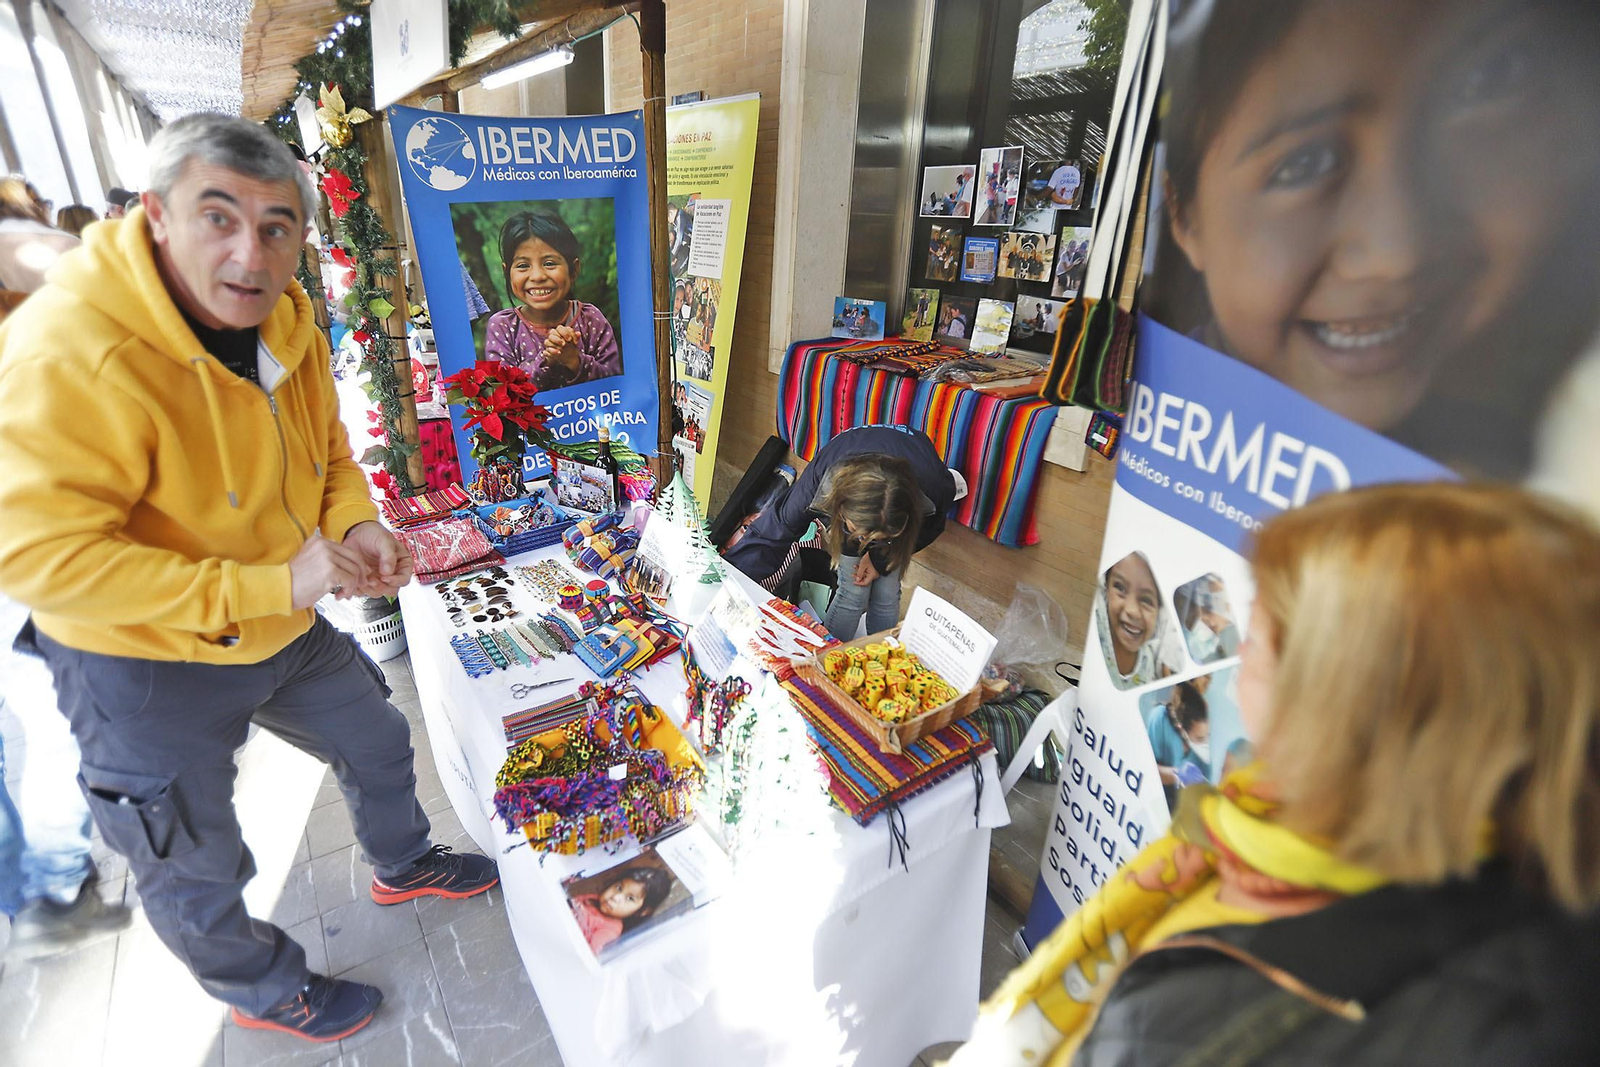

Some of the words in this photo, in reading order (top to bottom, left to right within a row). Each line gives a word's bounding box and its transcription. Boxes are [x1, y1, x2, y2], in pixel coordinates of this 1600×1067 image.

[477, 126, 637, 165] IBERMED
[483, 166, 535, 181] Médicos
[538, 170, 560, 180] con
[563, 166, 637, 180] Iberoamérica
[599, 389, 621, 408] DE
[603, 410, 648, 428] PARA
[1124, 380, 1351, 511] IBERMED
[1121, 447, 1171, 488] Médicos
[1173, 479, 1204, 503] con
[924, 607, 977, 653] QUITAPENAS
[937, 628, 966, 656] GUATEMALA
[1073, 706, 1144, 797] Salud
[1067, 743, 1149, 848] Iguald
[1048, 846, 1090, 906] Sos
